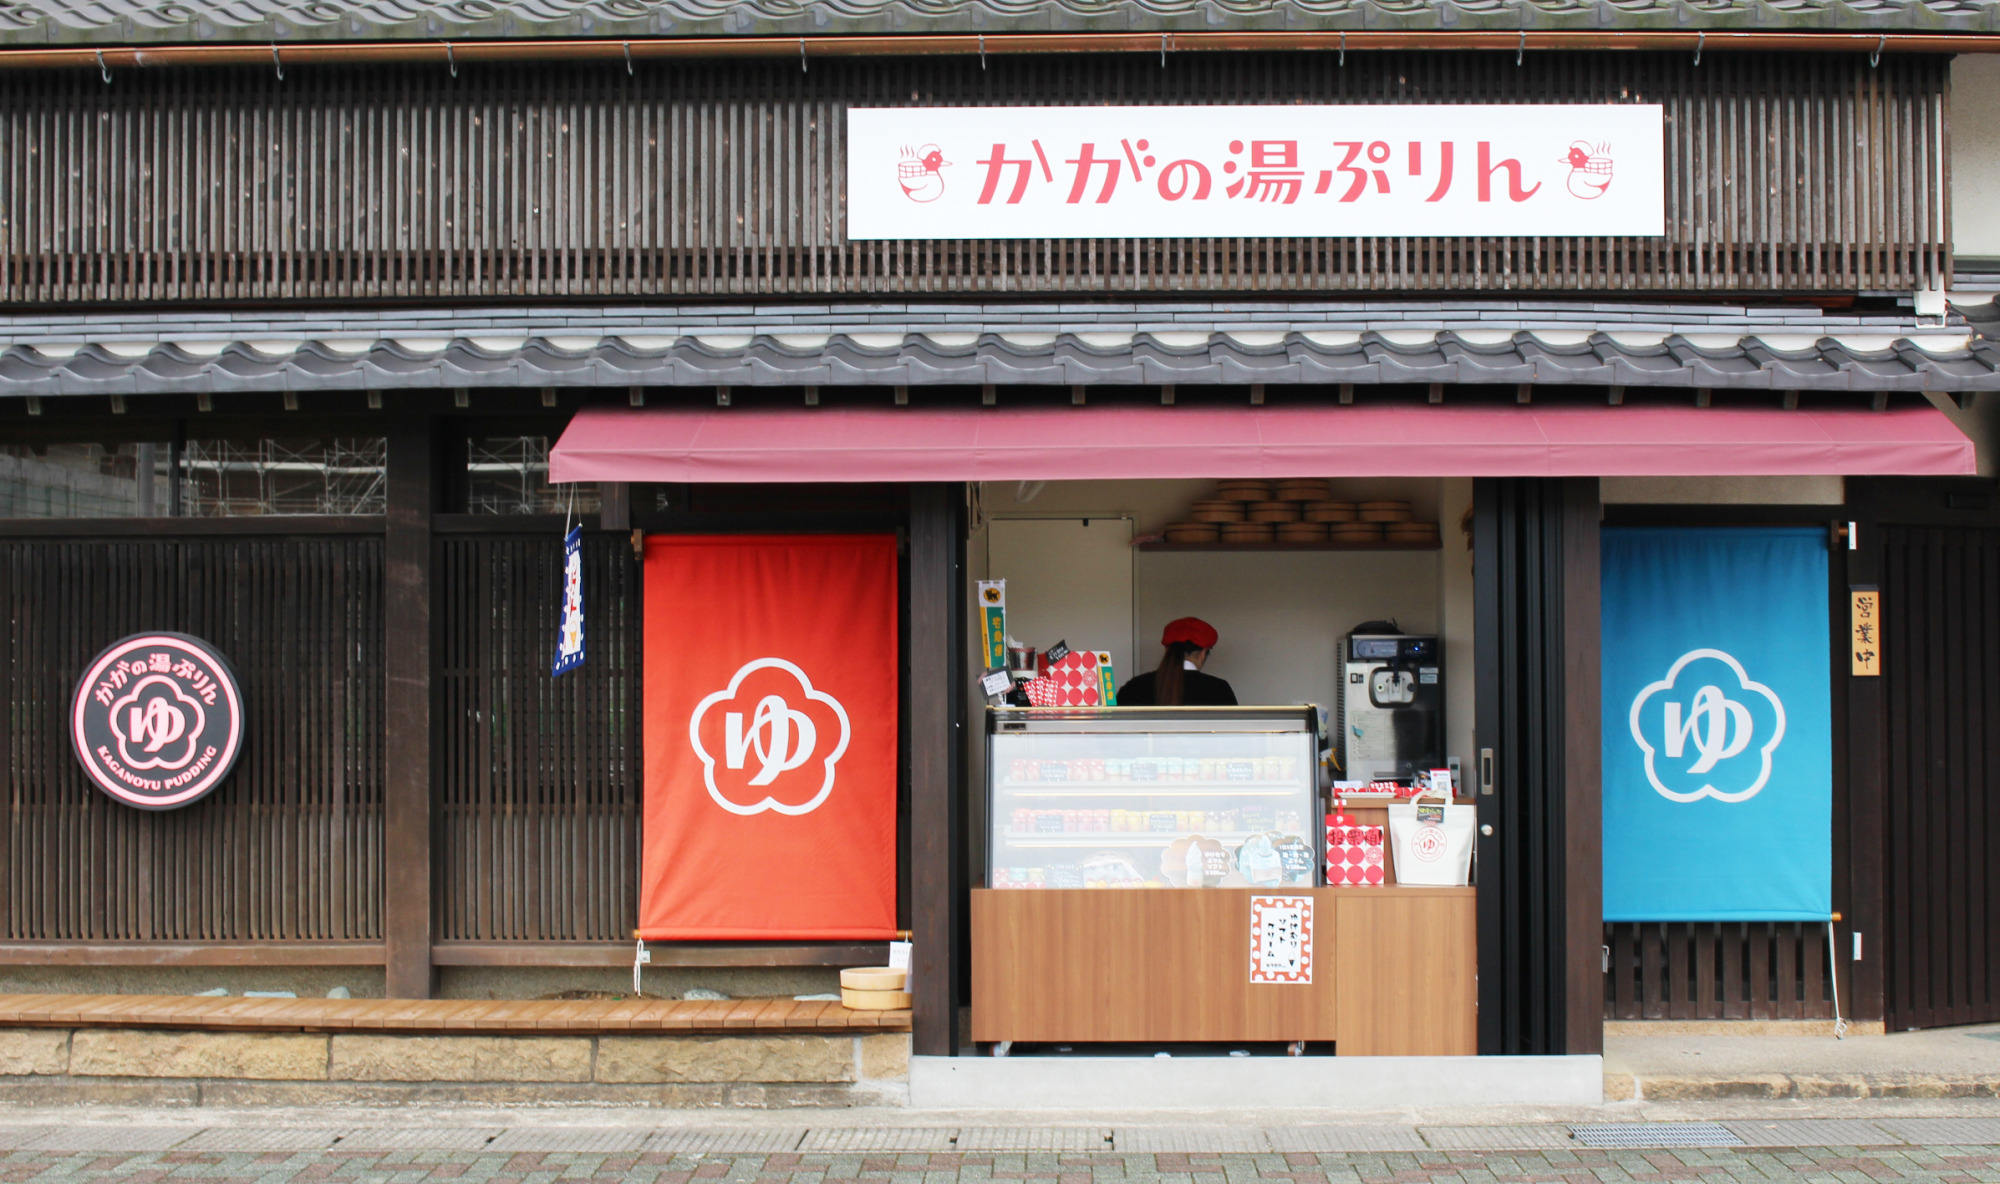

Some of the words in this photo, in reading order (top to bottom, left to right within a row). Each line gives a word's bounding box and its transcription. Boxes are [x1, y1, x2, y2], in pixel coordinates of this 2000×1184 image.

[976, 138, 1542, 205] かがの湯ぷりん
[1855, 596, 1875, 670] 営業中
[94, 653, 218, 706] かがの湯ぷりん
[130, 696, 186, 752] ゆ
[724, 694, 817, 786] ゆ
[1663, 684, 1753, 774] ゆ
[97, 745, 161, 790] KAGANOYU
[164, 745, 217, 790] PUDDING
